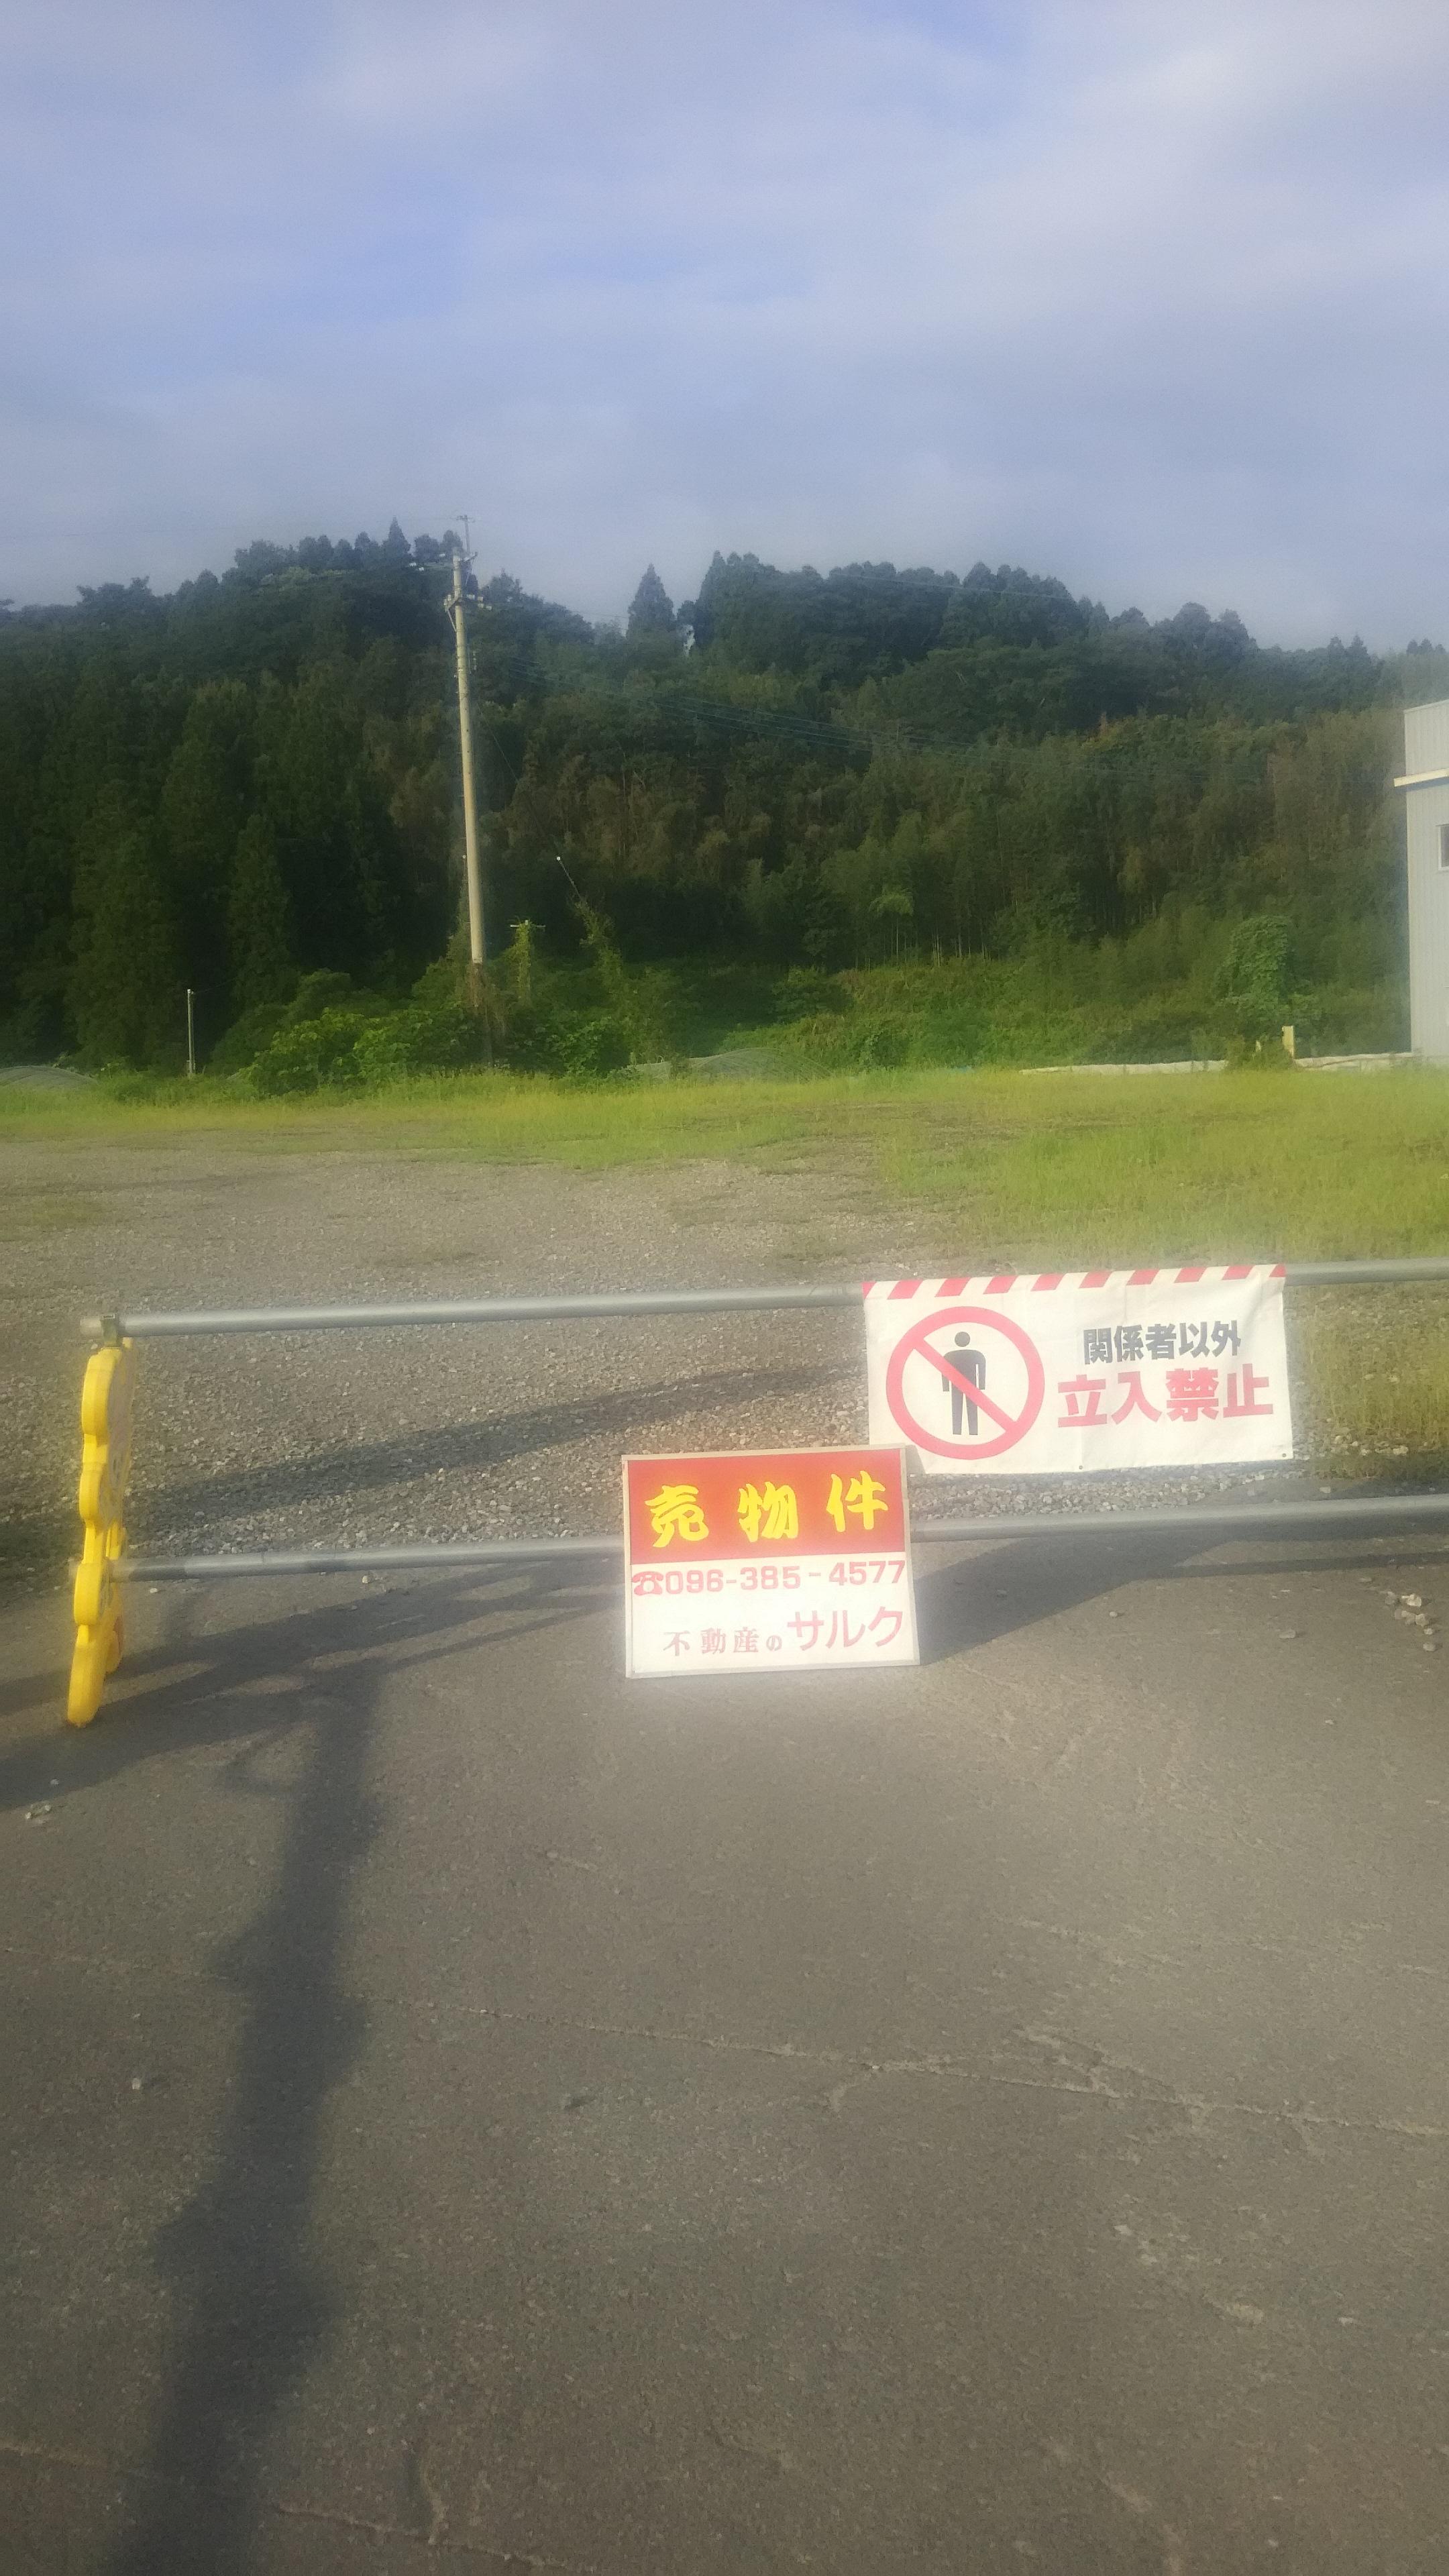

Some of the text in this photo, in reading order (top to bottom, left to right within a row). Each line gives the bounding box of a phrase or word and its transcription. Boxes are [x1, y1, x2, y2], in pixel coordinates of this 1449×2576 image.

[1084, 1320, 1240, 1364] 関係者以外
[1058, 1364, 1273, 1427] 立入禁止
[645, 1470, 888, 1548] 売物件
[663, 1607, 902, 1656] 不動産のサルク
